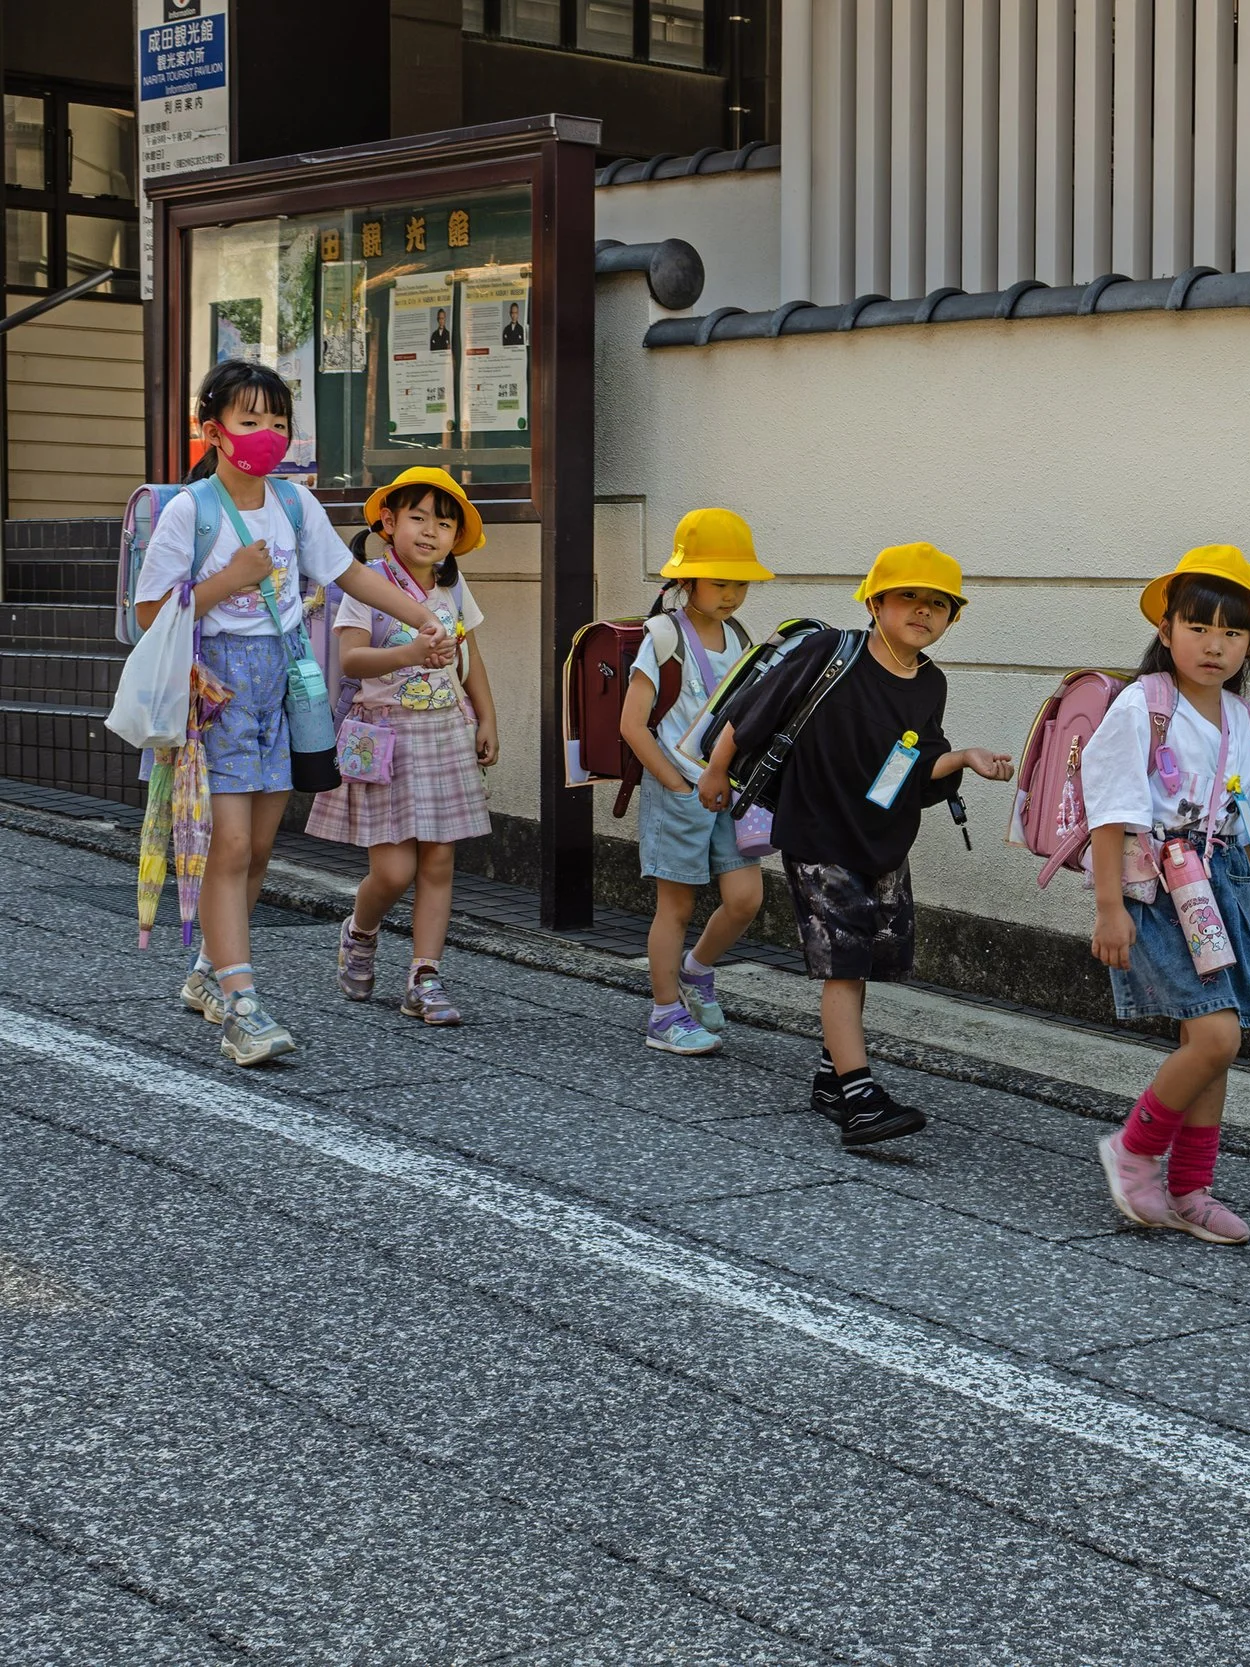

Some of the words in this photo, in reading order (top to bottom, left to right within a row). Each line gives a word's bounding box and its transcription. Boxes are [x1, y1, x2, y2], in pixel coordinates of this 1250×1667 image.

[168, 8, 197, 19] Information
[148, 18, 214, 53] 成田観光館
[157, 46, 205, 71] 観光案内所
[143, 73, 166, 86] NARITA
[165, 67, 194, 82] TOURIST
[194, 62, 224, 77] PAVILION
[165, 82, 198, 95] Information
[164, 95, 204, 114] 利用案内
